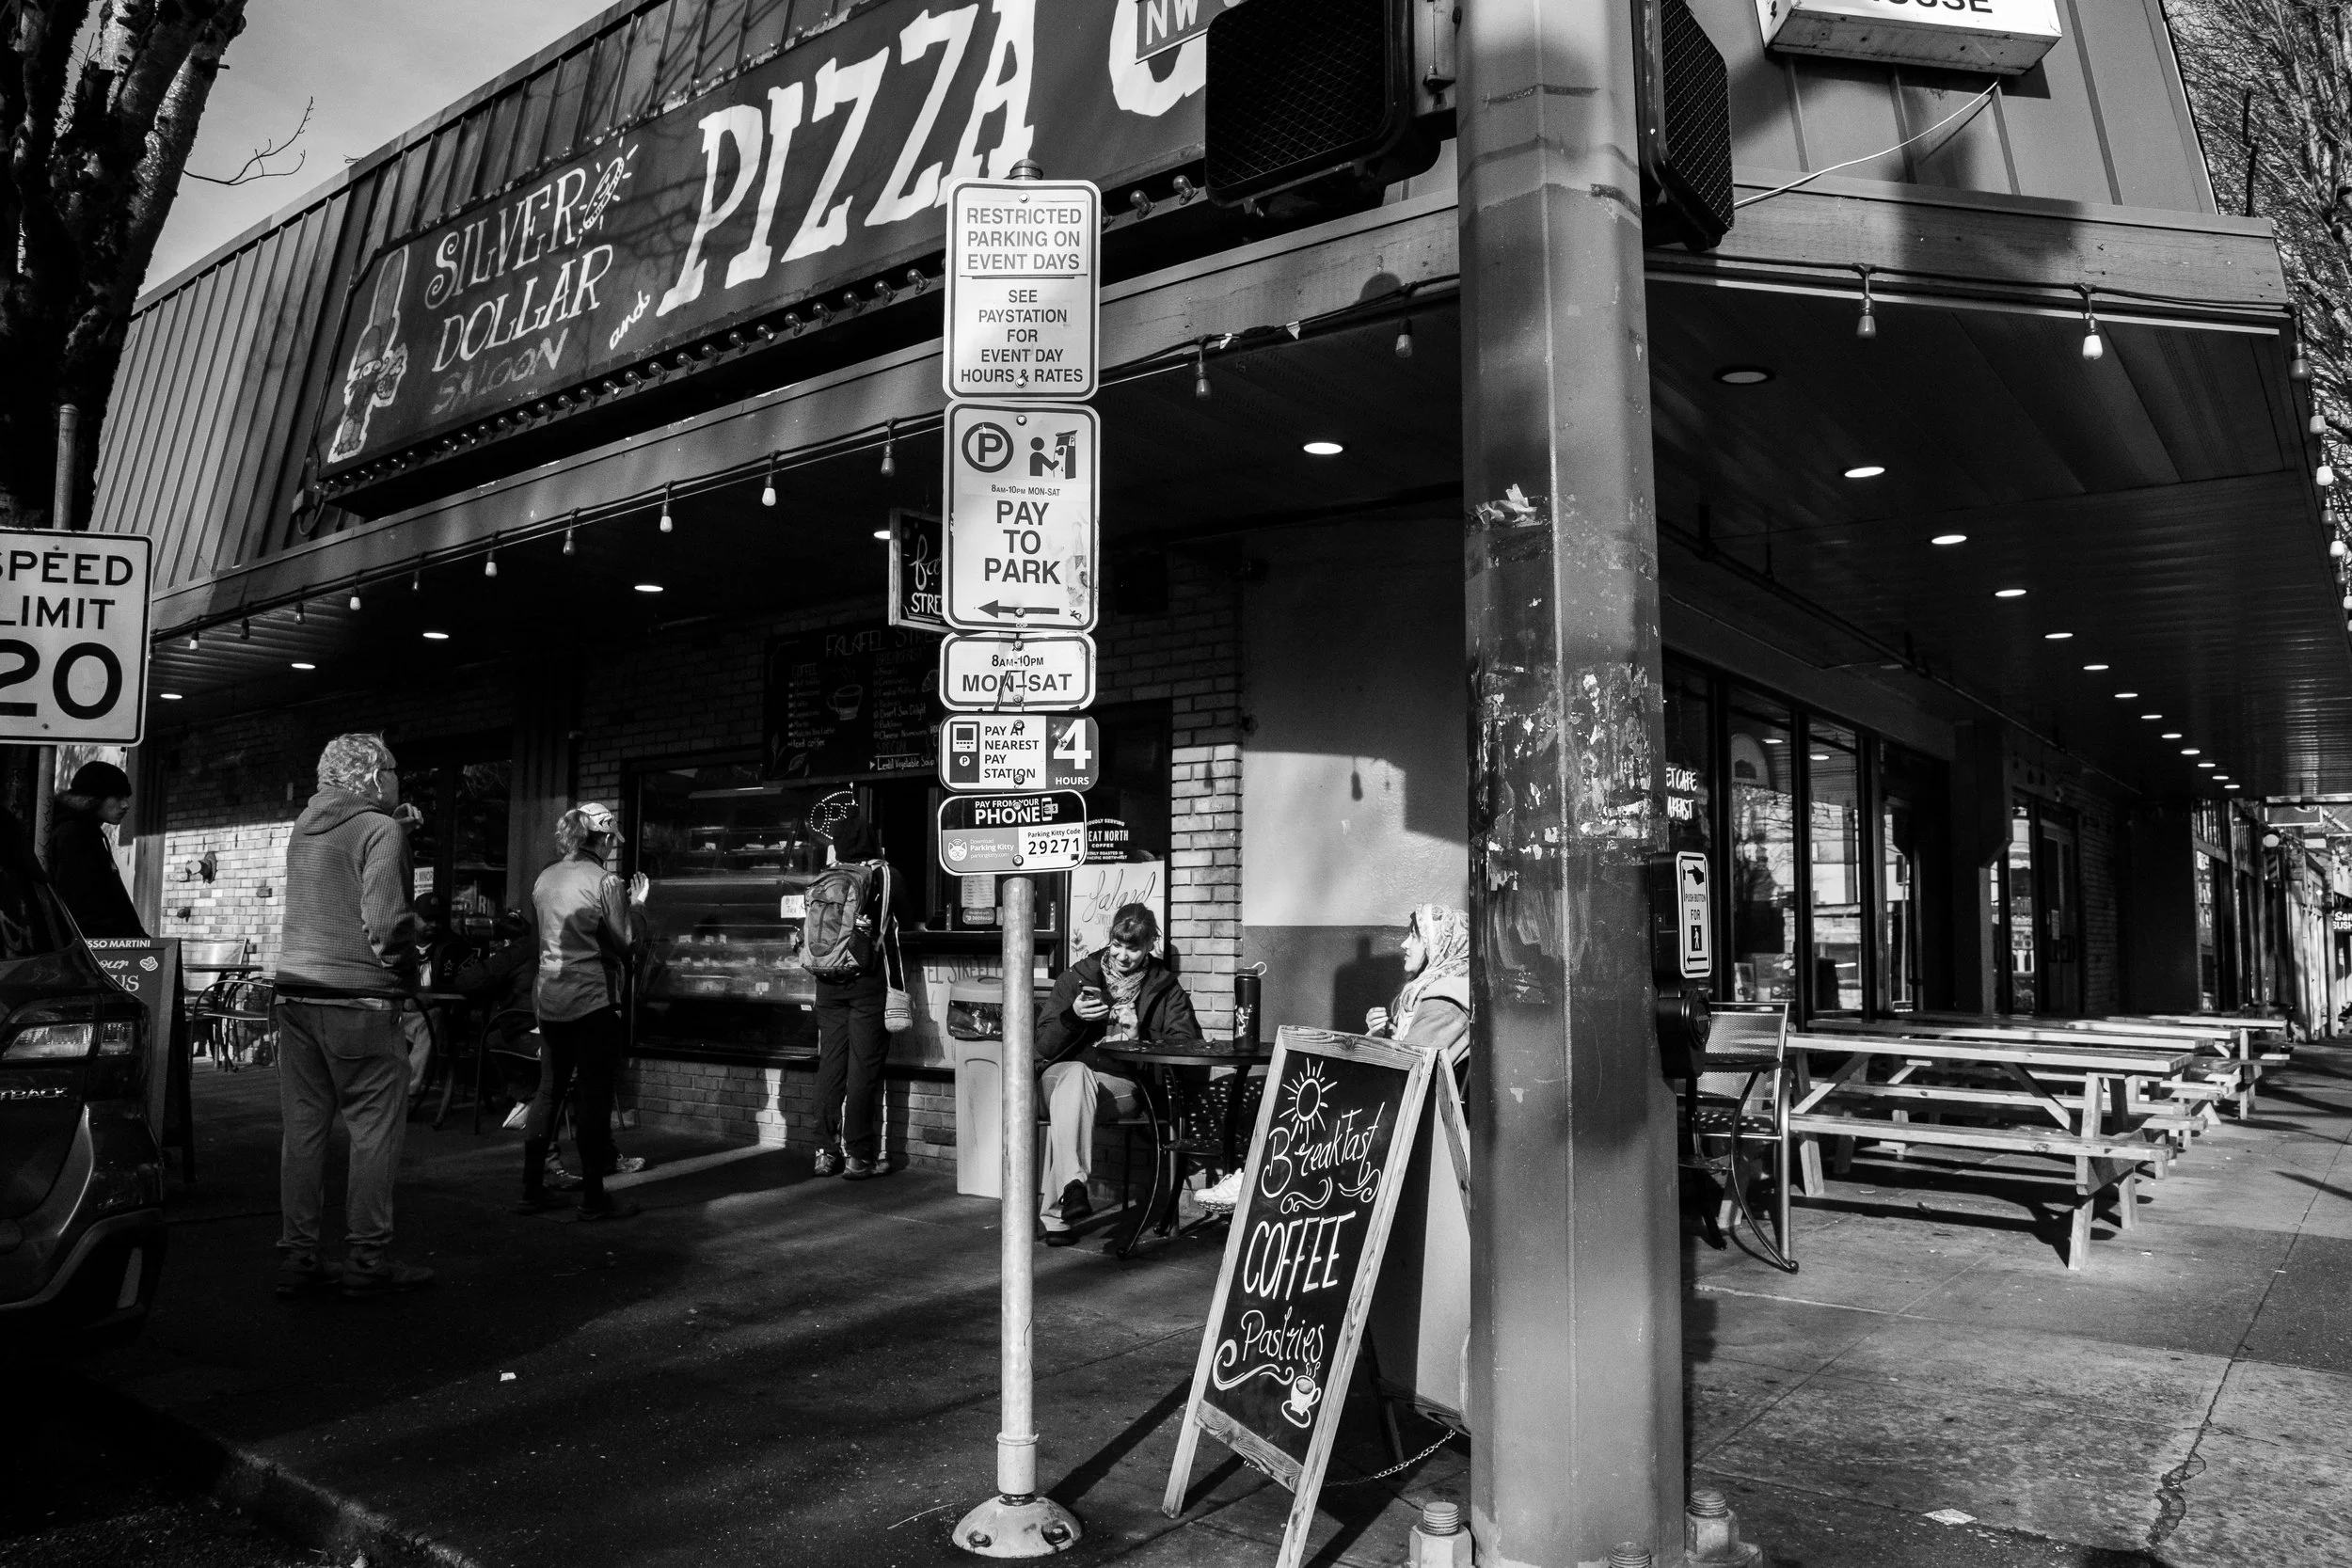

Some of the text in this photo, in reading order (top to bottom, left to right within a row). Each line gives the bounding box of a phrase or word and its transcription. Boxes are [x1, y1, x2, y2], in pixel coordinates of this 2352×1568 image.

[609, 290, 651, 350] and
[656, 0, 1034, 316] PIZZA
[966, 208, 1082, 225] RESTRICTED
[424, 167, 585, 309] SILVER
[967, 230, 1080, 247] PARKING ON
[967, 253, 1080, 270] EVENT DAYS
[1009, 290, 1038, 303] SEE
[432, 244, 612, 372] DOLLAR
[978, 309, 1067, 323] PAYSTATION
[1007, 329, 1038, 342] FOR
[981, 349, 1064, 362] EVENT DAY
[961, 369, 1083, 383] HOURS & RATES
[1028, 487, 1060, 497] MON-SAT
[996, 499, 1049, 526] PAY
[1003, 530, 1041, 555] TO
[0, 550, 134, 586] PEED
[984, 558, 1061, 585] PARK
[0, 639, 123, 720] 20
[985, 725, 1024, 736] PAY AT
[985, 740, 1040, 751] NEAREST
[1053, 719, 1091, 769] 4
[985, 754, 1007, 764] PAY
[984, 768, 1036, 779] STATION
[1055, 777, 1089, 785] HOURS
[975, 798, 1040, 809] PAY FROM YOUR
[975, 806, 1041, 825] PHONE
[1051, 830, 1065, 838] Kitty
[1104, 830, 1129, 841] NORTH
[970, 843, 1014, 852] Parking Kitty
[1027, 837, 1080, 856] 29271
[1691, 909, 1701, 921] FOR
[109, 939, 151, 948] MARTINI
[1243, 1211, 1356, 1301] COFFEE
[1241, 1306, 1325, 1364] Pastries
